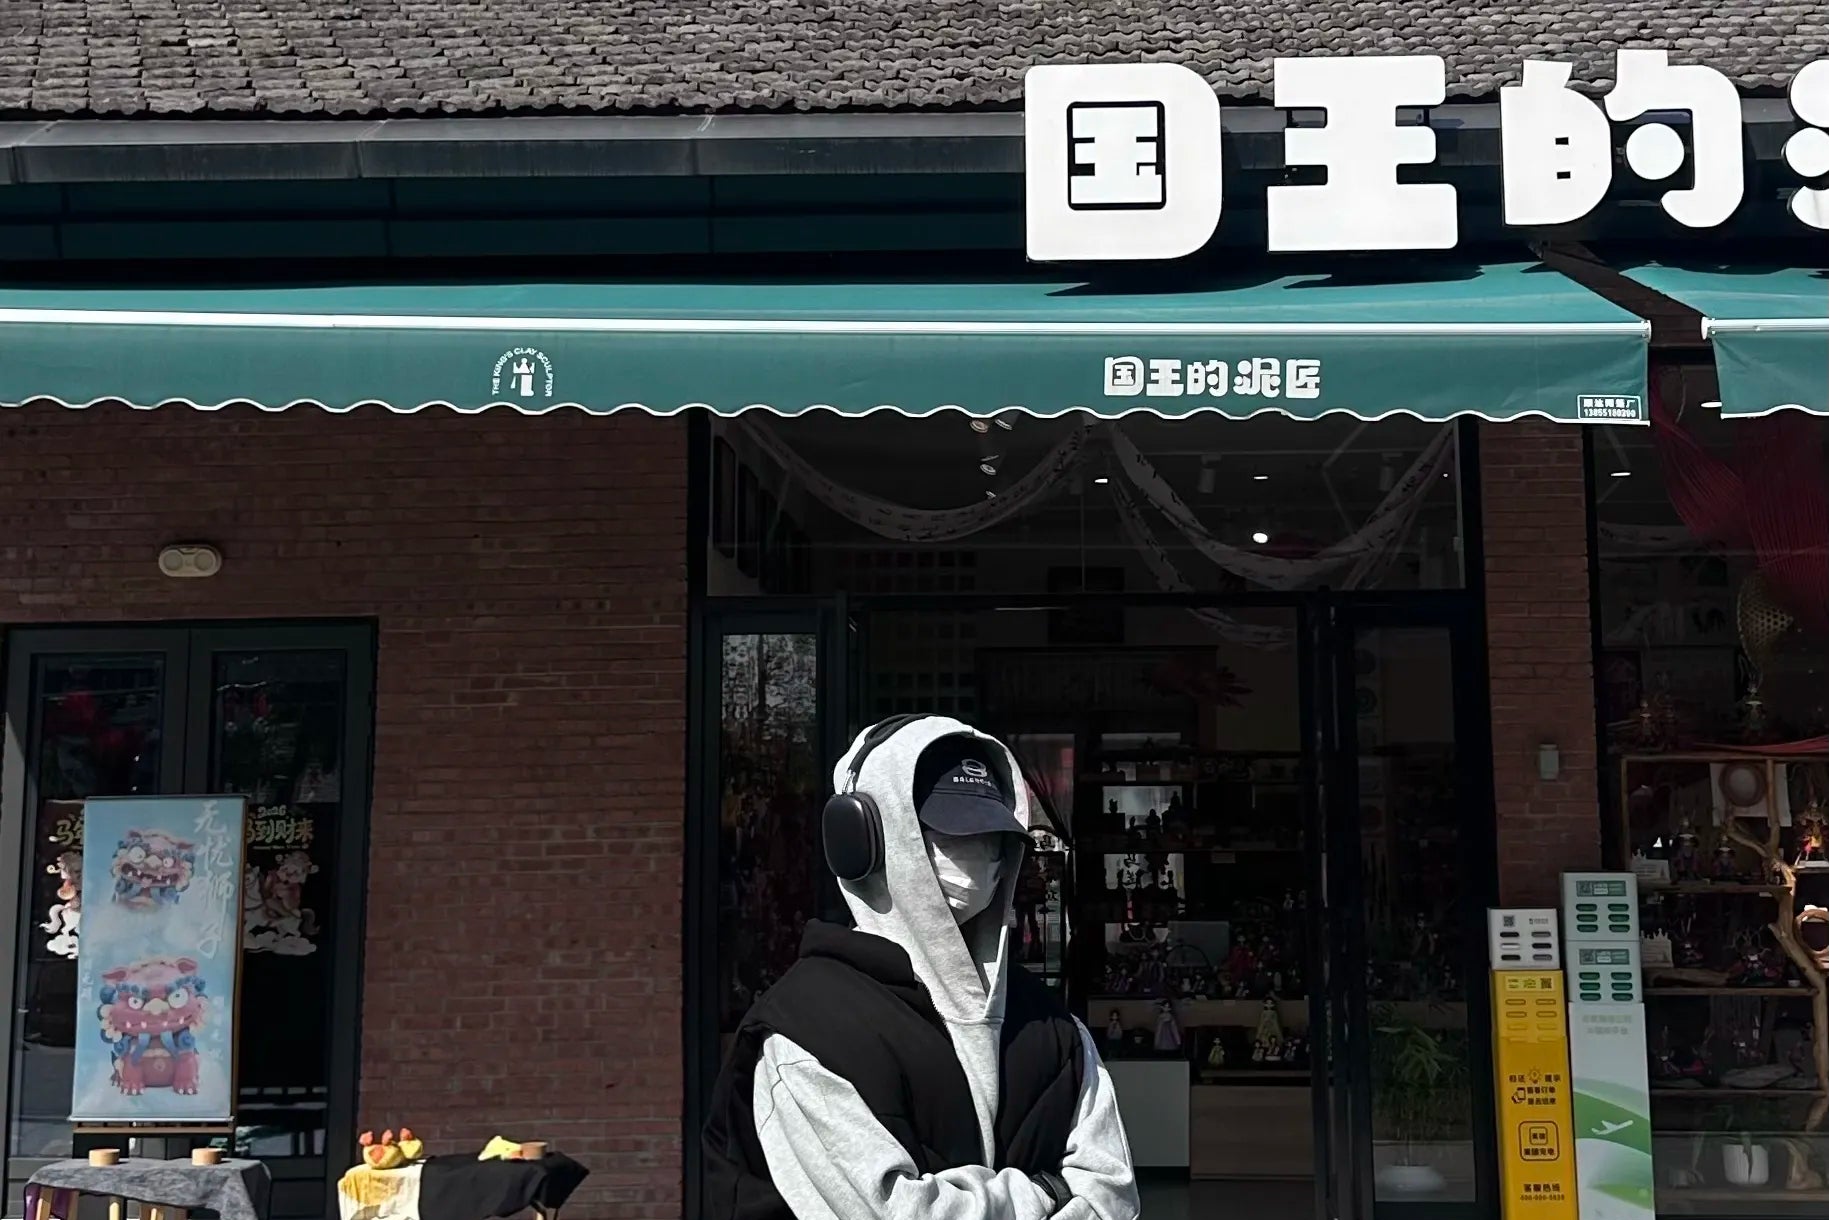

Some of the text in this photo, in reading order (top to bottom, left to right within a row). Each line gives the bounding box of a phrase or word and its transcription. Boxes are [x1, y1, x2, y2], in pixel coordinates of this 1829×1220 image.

[1025, 49, 1829, 261] 国王的
[1103, 355, 1321, 399] 国王的泥匠
